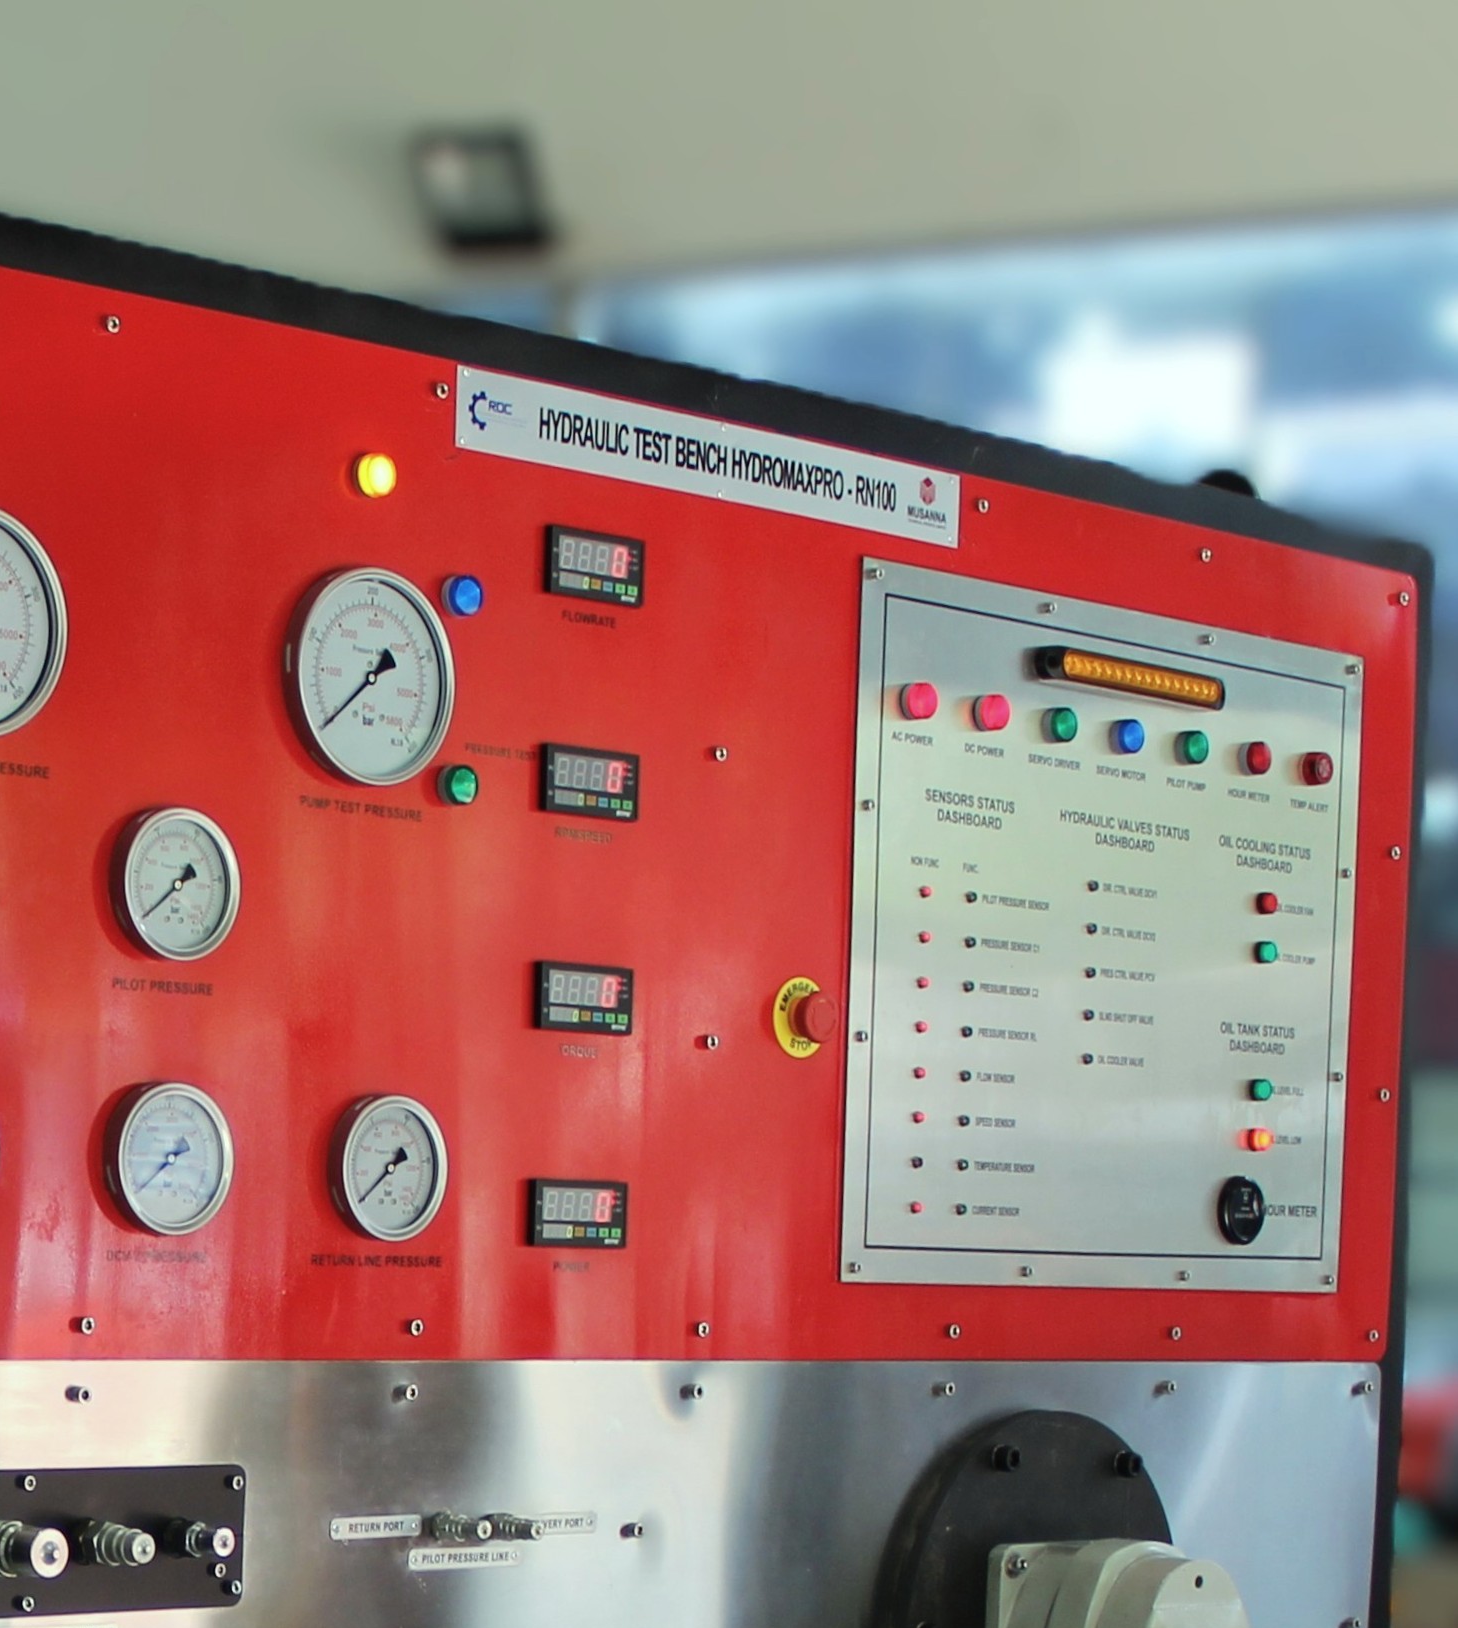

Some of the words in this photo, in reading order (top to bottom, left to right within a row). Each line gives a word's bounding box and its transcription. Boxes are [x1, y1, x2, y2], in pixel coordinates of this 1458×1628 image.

[539, 407, 629, 456] HYDRAULIC
[633, 427, 671, 464] TEST
[675, 436, 728, 476] BENCH
[732, 448, 844, 500] HYDROMAXPRO
[856, 476, 896, 512] RN100
[907, 506, 947, 524] MUSANNA
[562, 610, 617, 629] FLOWRATE
[362, 714, 374, 726] bar
[892, 731, 903, 742] AC
[905, 733, 933, 746] POWER
[964, 743, 975, 753] DC
[977, 745, 1005, 758] POWER
[1028, 753, 1053, 766] SERVO
[1055, 757, 1080, 771] DRIVER
[1096, 765, 1120, 778] SERVO
[1121, 768, 1146, 782] MOTOR
[1166, 777, 1186, 790] PILOT
[1187, 780, 1206, 792] PUMP
[925, 788, 975, 809] SENSORS
[977, 797, 1015, 814] STATUS
[1228, 788, 1246, 799] HOUR
[1248, 791, 1270, 803] METER
[299, 795, 330, 810] PUMP
[334, 800, 362, 814] TEST
[365, 803, 422, 822] PRESSURE
[1290, 799, 1307, 811] TEMP
[1308, 801, 1328, 813] ALERT
[937, 808, 1002, 830] DASHBOARD
[1060, 810, 1115, 831] HYDRAULIC
[1117, 817, 1153, 836] VALVES
[1155, 823, 1190, 841] STATUS
[1095, 833, 1155, 853] DASHBOARD
[1218, 834, 1234, 849] OIL
[1236, 837, 1276, 855] COOLING
[1278, 844, 1311, 860] STATUS
[1236, 854, 1292, 874] DASHBOARD
[982, 894, 998, 904] PILOT
[999, 896, 1026, 909] PRESSURE
[1028, 899, 1050, 911] SENSOR
[981, 938, 1009, 950] PRESSURE
[1010, 941, 1032, 953] SENSOR
[112, 977, 147, 991] PILOT
[150, 980, 213, 995] PRESSURE
[980, 983, 1008, 995] PRESSURE
[1009, 985, 1031, 996] SENSOR
[978, 1028, 1006, 1039] PRESSURE
[1007, 1030, 1029, 1041] SENSOR
[1220, 1021, 1235, 1034] OIL
[1237, 1023, 1260, 1037] TANK
[1262, 1026, 1295, 1040] STATUS
[1229, 1039, 1285, 1055] DASHBOARD
[993, 1073, 1015, 1084] SENSOR
[994, 1118, 1016, 1129] SENSOR
[974, 1160, 1012, 1173] TEMPERATURE
[1013, 1163, 1035, 1174] SENSOR
[972, 1206, 997, 1217] CURRENT
[998, 1207, 1020, 1217] SENSOR
[1288, 1206, 1317, 1218] METER
[311, 1254, 354, 1267] RETURN
[358, 1256, 382, 1267] LINE
[385, 1256, 442, 1268] PRESSURE
[348, 1521, 381, 1533] RETURN
[383, 1520, 404, 1532] PORT
[564, 1516, 585, 1528] PORT
[422, 1552, 445, 1564] PILOT
[447, 1551, 489, 1563] PRESSURE
[491, 1551, 510, 1562] LINE
